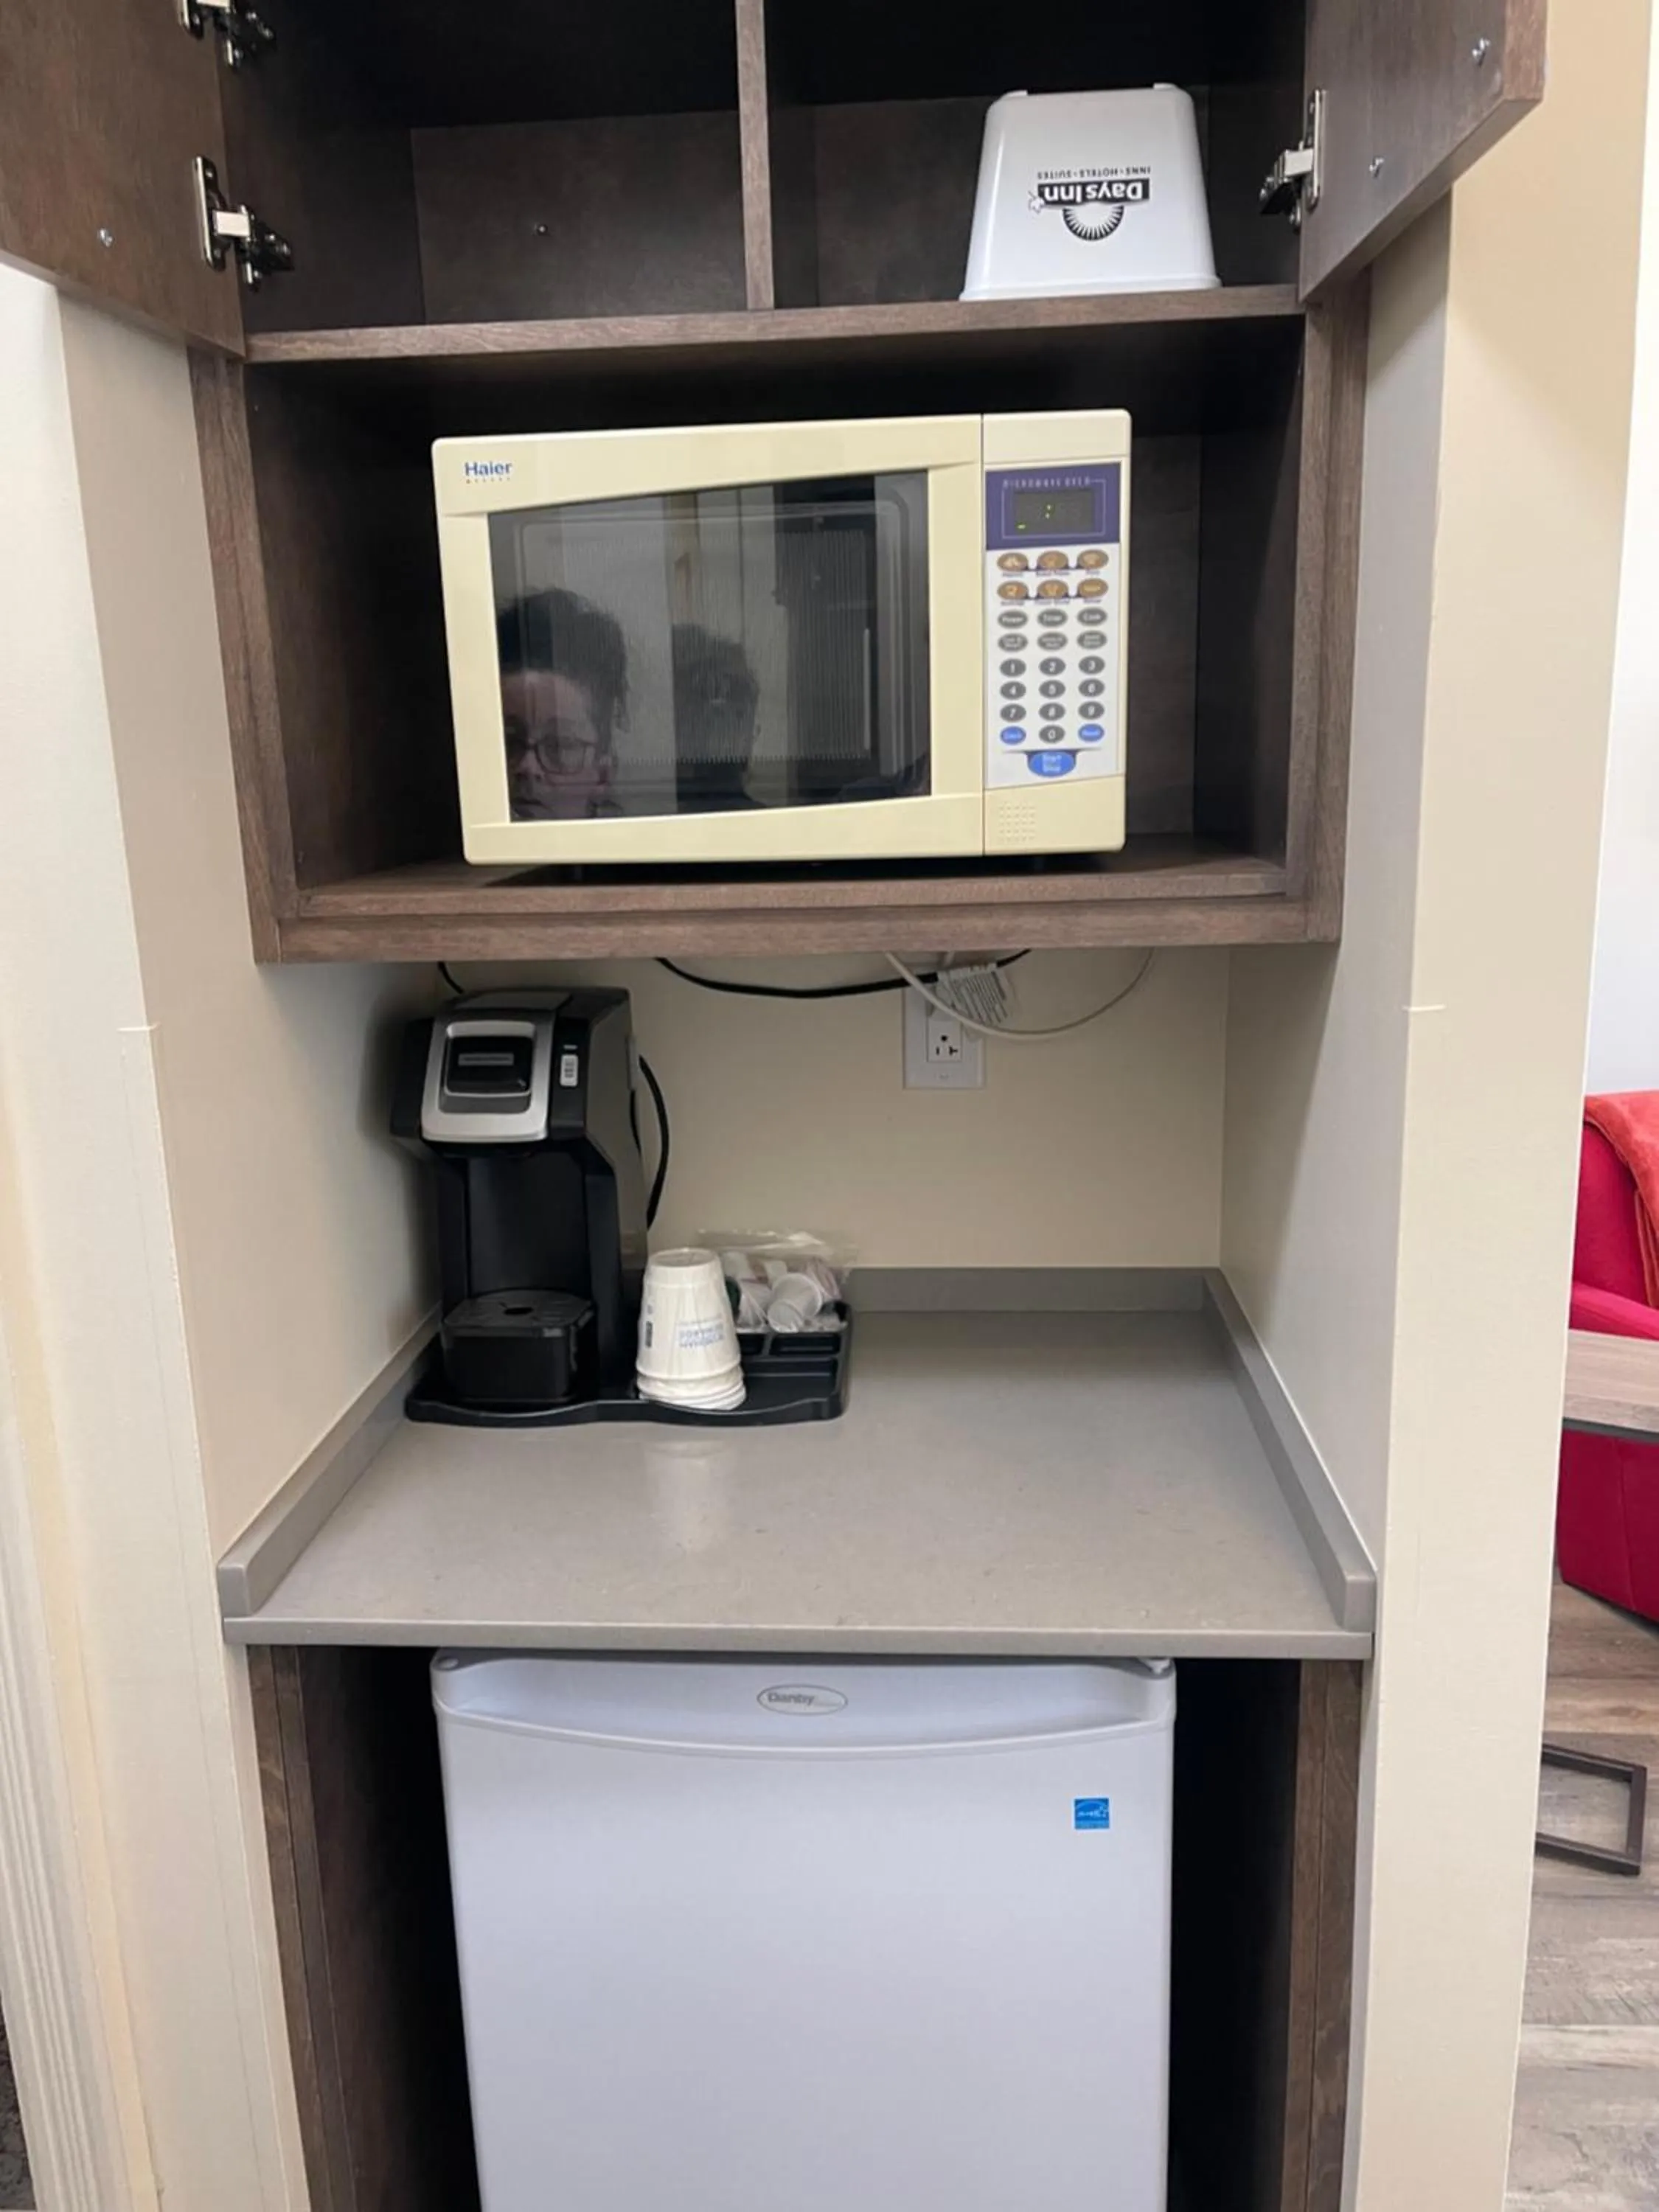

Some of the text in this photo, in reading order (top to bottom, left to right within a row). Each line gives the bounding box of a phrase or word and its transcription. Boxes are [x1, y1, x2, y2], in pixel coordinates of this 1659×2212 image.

[1037, 166, 1151, 180] INNS HOTELS SUITES
[1044, 181, 1144, 204] Days Inn
[464, 461, 512, 476] Haier
[1048, 661, 1057, 672] 2
[1088, 660, 1096, 671] 3
[1009, 685, 1017, 695] 4
[1048, 684, 1057, 695] 5
[1088, 683, 1096, 693] 6
[1009, 707, 1016, 719] 7
[1048, 706, 1056, 717] 8
[1088, 705, 1095, 717] 9
[1047, 728, 1056, 740] 0
